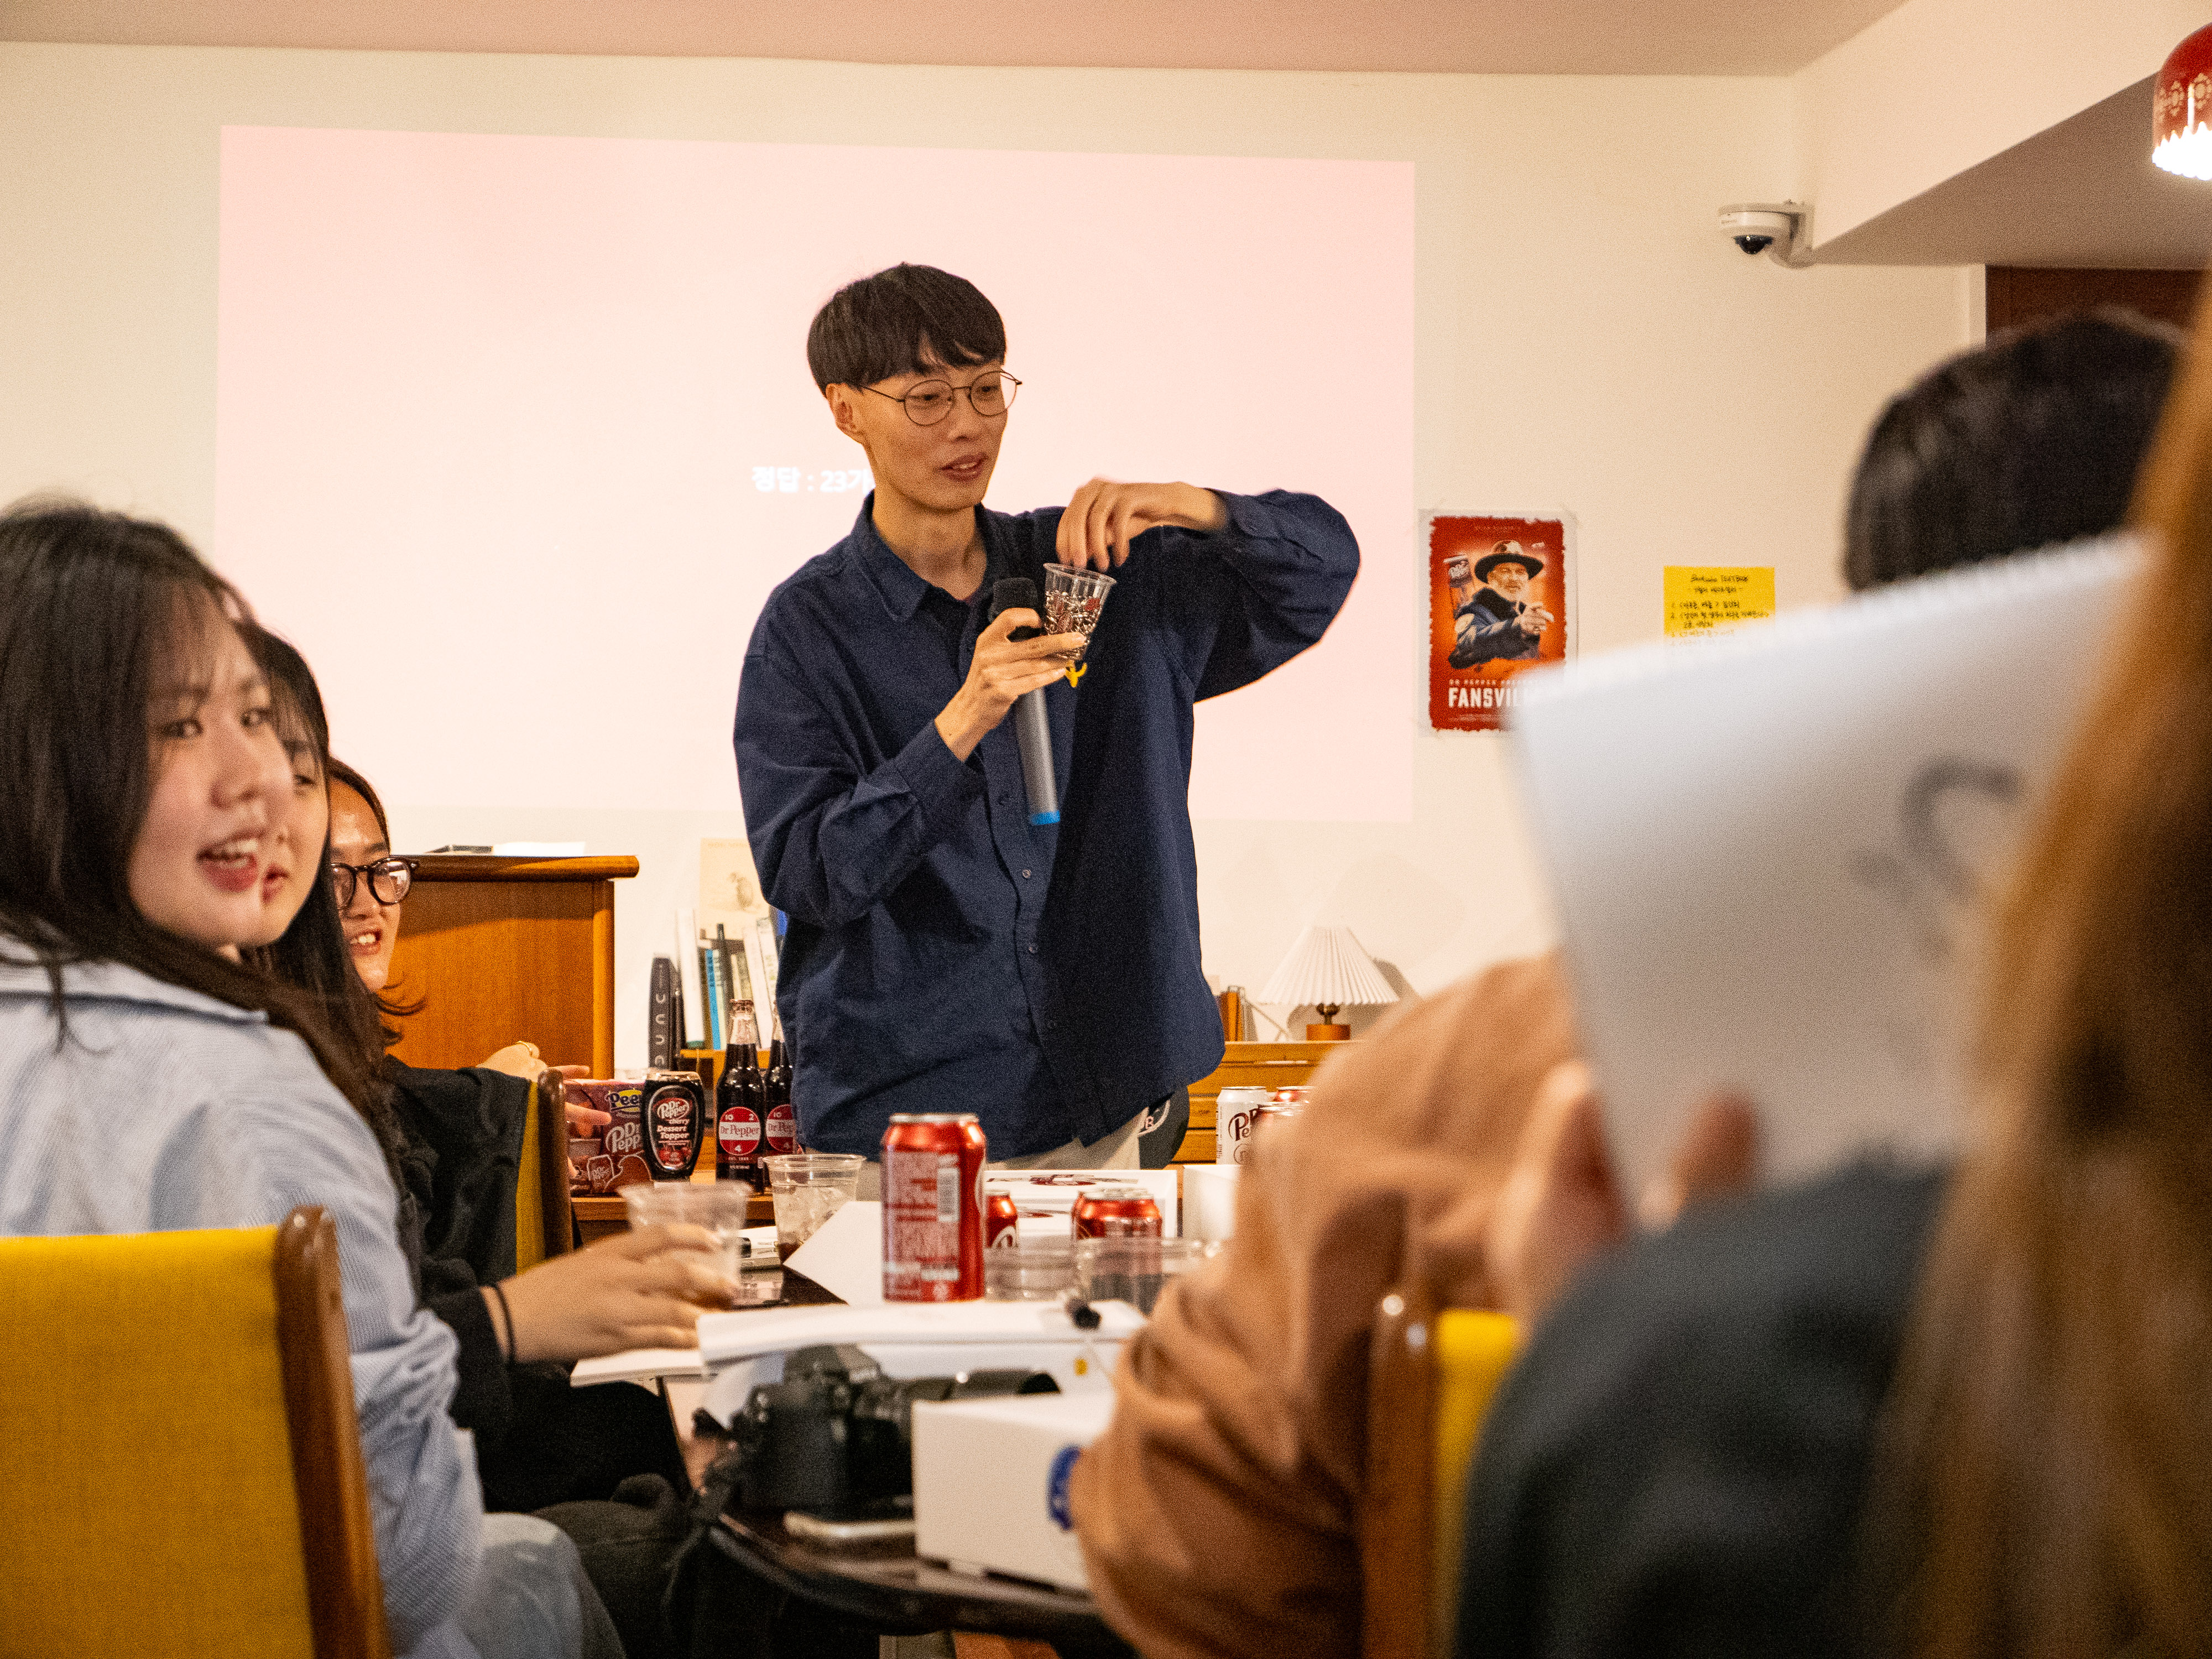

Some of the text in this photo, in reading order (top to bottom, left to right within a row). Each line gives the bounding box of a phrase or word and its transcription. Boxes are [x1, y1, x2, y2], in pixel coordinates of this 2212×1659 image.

[752, 466, 801, 493] 정답
[1448, 687, 1523, 708] FANSVIL
[607, 1092, 641, 1108] Pee
[658, 1103, 687, 1119] Pepper
[721, 1124, 760, 1138] Dr Pepper
[768, 1121, 794, 1134] Dr Pep
[606, 1126, 641, 1153] Pepp
[734, 1144, 742, 1152] 4
